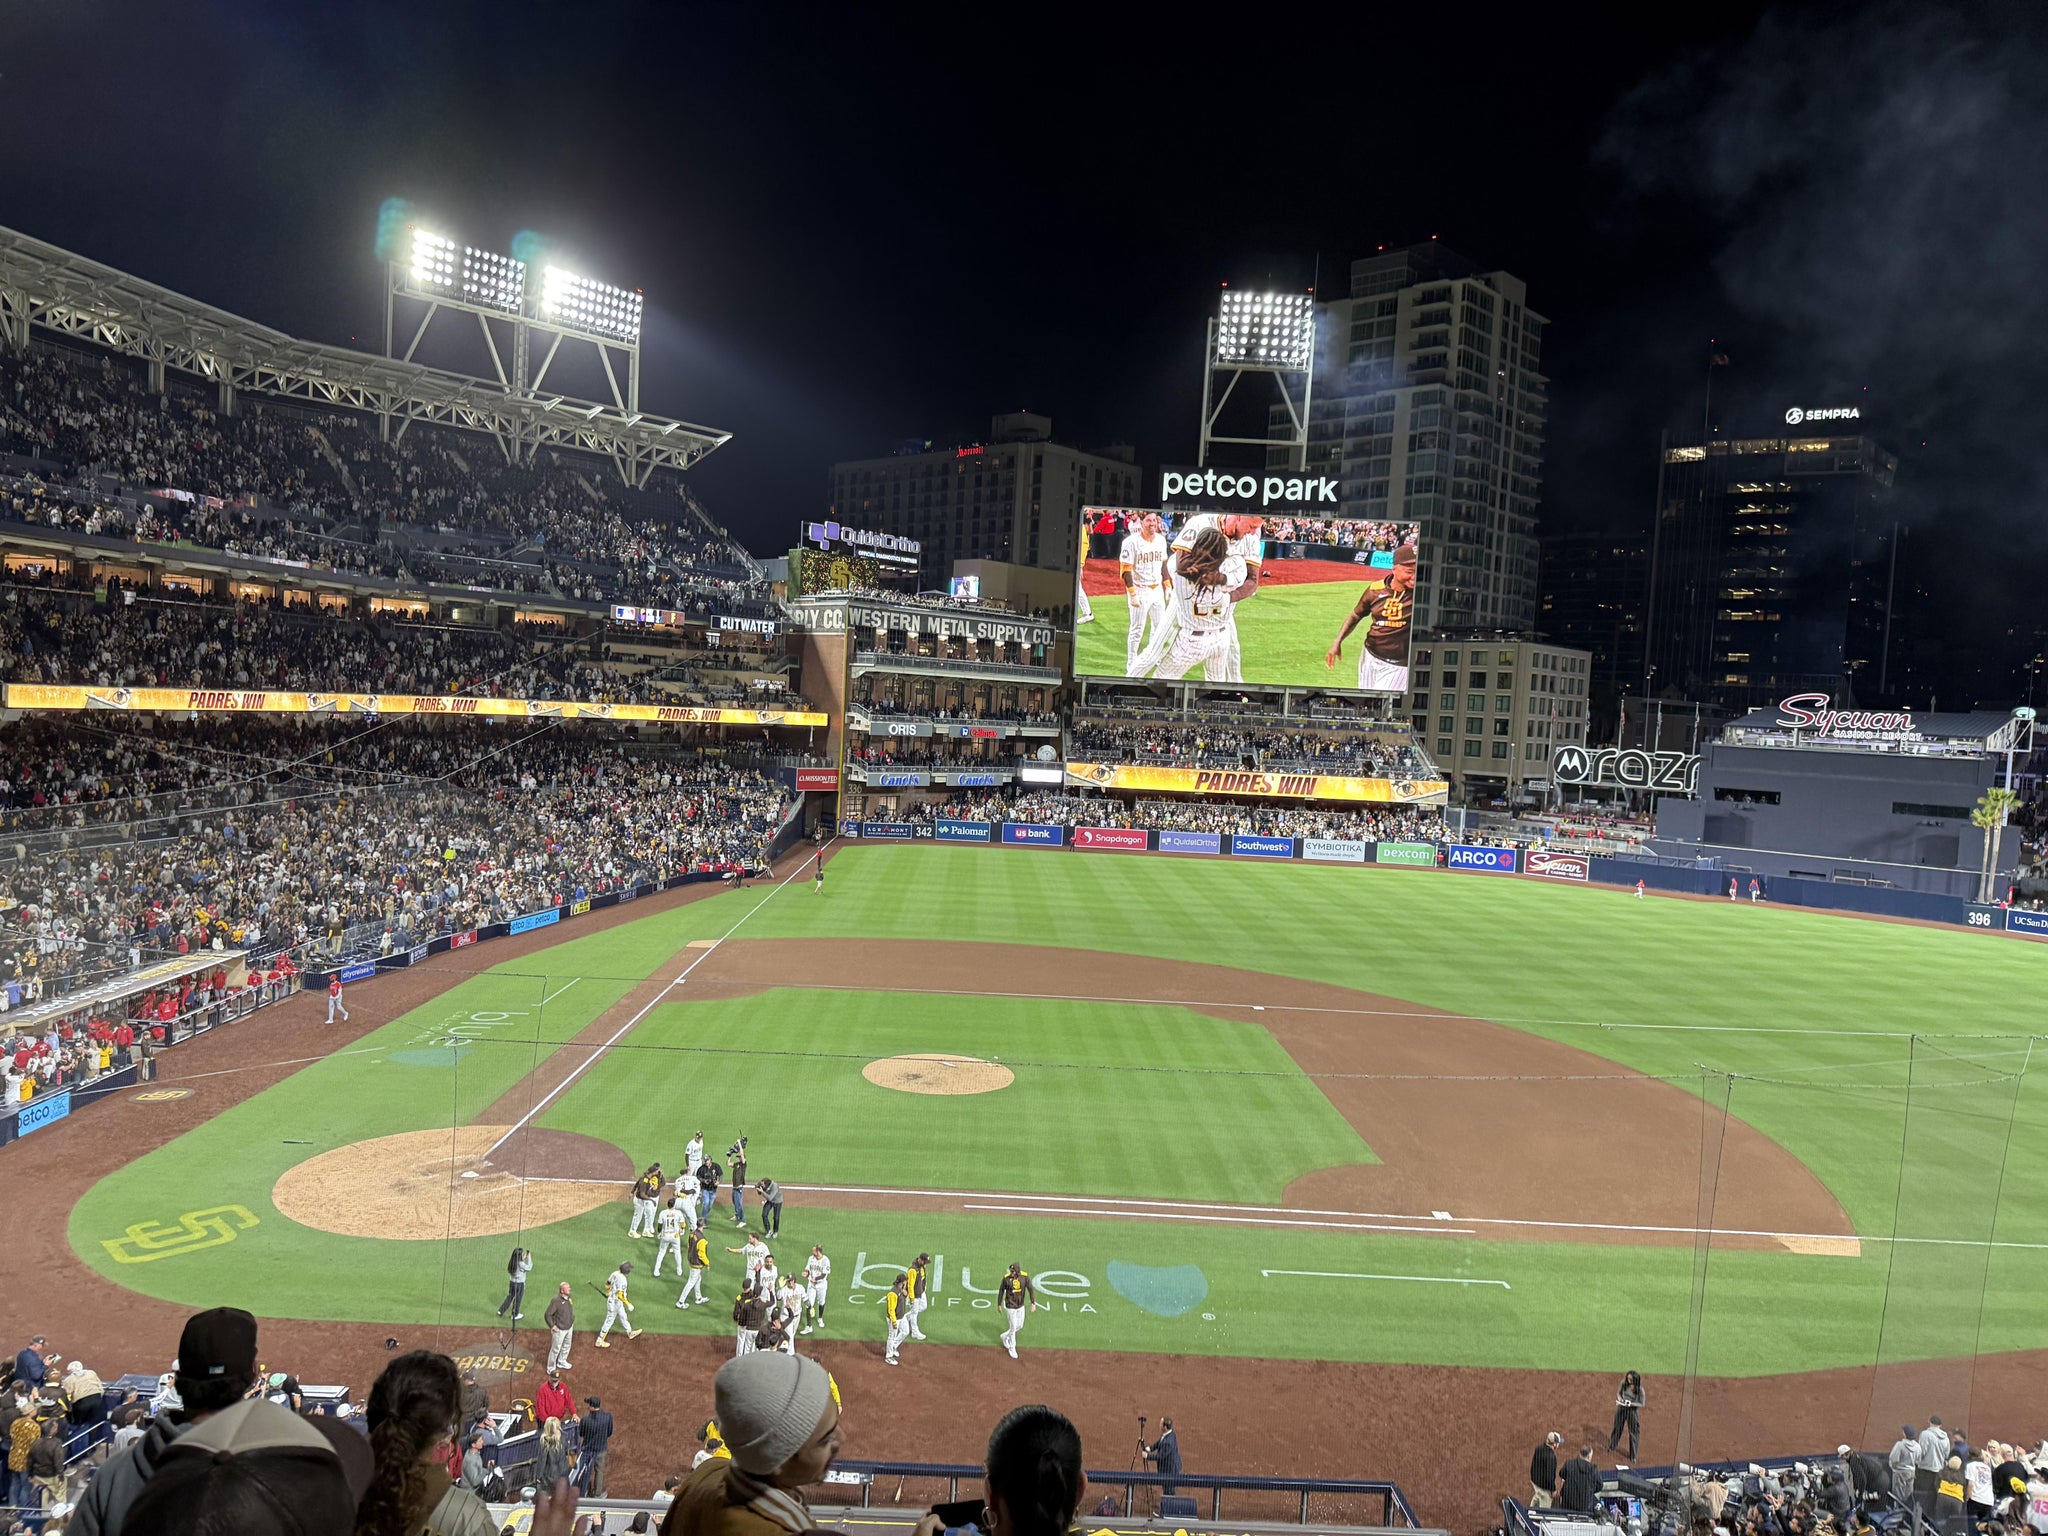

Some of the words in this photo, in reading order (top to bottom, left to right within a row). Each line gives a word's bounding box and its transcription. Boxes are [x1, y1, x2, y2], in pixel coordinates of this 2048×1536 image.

[1805, 407, 1860, 421] SEMPRA
[1162, 469, 1257, 502] petco
[1263, 477, 1338, 506] park
[841, 527, 920, 554] QuidelOrtho
[719, 617, 775, 633] CUTWATER
[849, 607, 920, 632] WESTERN
[928, 616, 974, 638] METAL
[977, 622, 1028, 643] SUPPLY
[1033, 629, 1054, 646] CO.
[187, 692, 239, 709] PADRES
[241, 693, 266, 710] WIN
[413, 698, 449, 712] PADRES
[451, 699, 478, 713] WIN
[657, 707, 699, 721] PADRES
[701, 708, 722, 722] WIN
[1776, 693, 1917, 737] Sycuan
[888, 724, 917, 736] ORIS
[1592, 748, 1701, 791] razr
[848, 784, 862, 794] 336
[1194, 770, 1274, 794] PADRES
[1277, 775, 1317, 797] WIN
[916, 827, 932, 837] 342
[951, 826, 988, 837] Palomar
[1028, 828, 1050, 838] bank
[1095, 833, 1143, 845] Snapdragon
[1173, 838, 1217, 848] QuidelOrtho
[1236, 840, 1283, 853] Southwest
[1305, 842, 1362, 852] CYMBIOTIKA
[1450, 850, 1497, 866] ARCO
[1529, 854, 1582, 875] Sycuan
[1968, 911, 1991, 926] 396
[2014, 916, 2026, 925] UC
[2026, 919, 2040, 927] San
[850, 1252, 1091, 1299] blue
